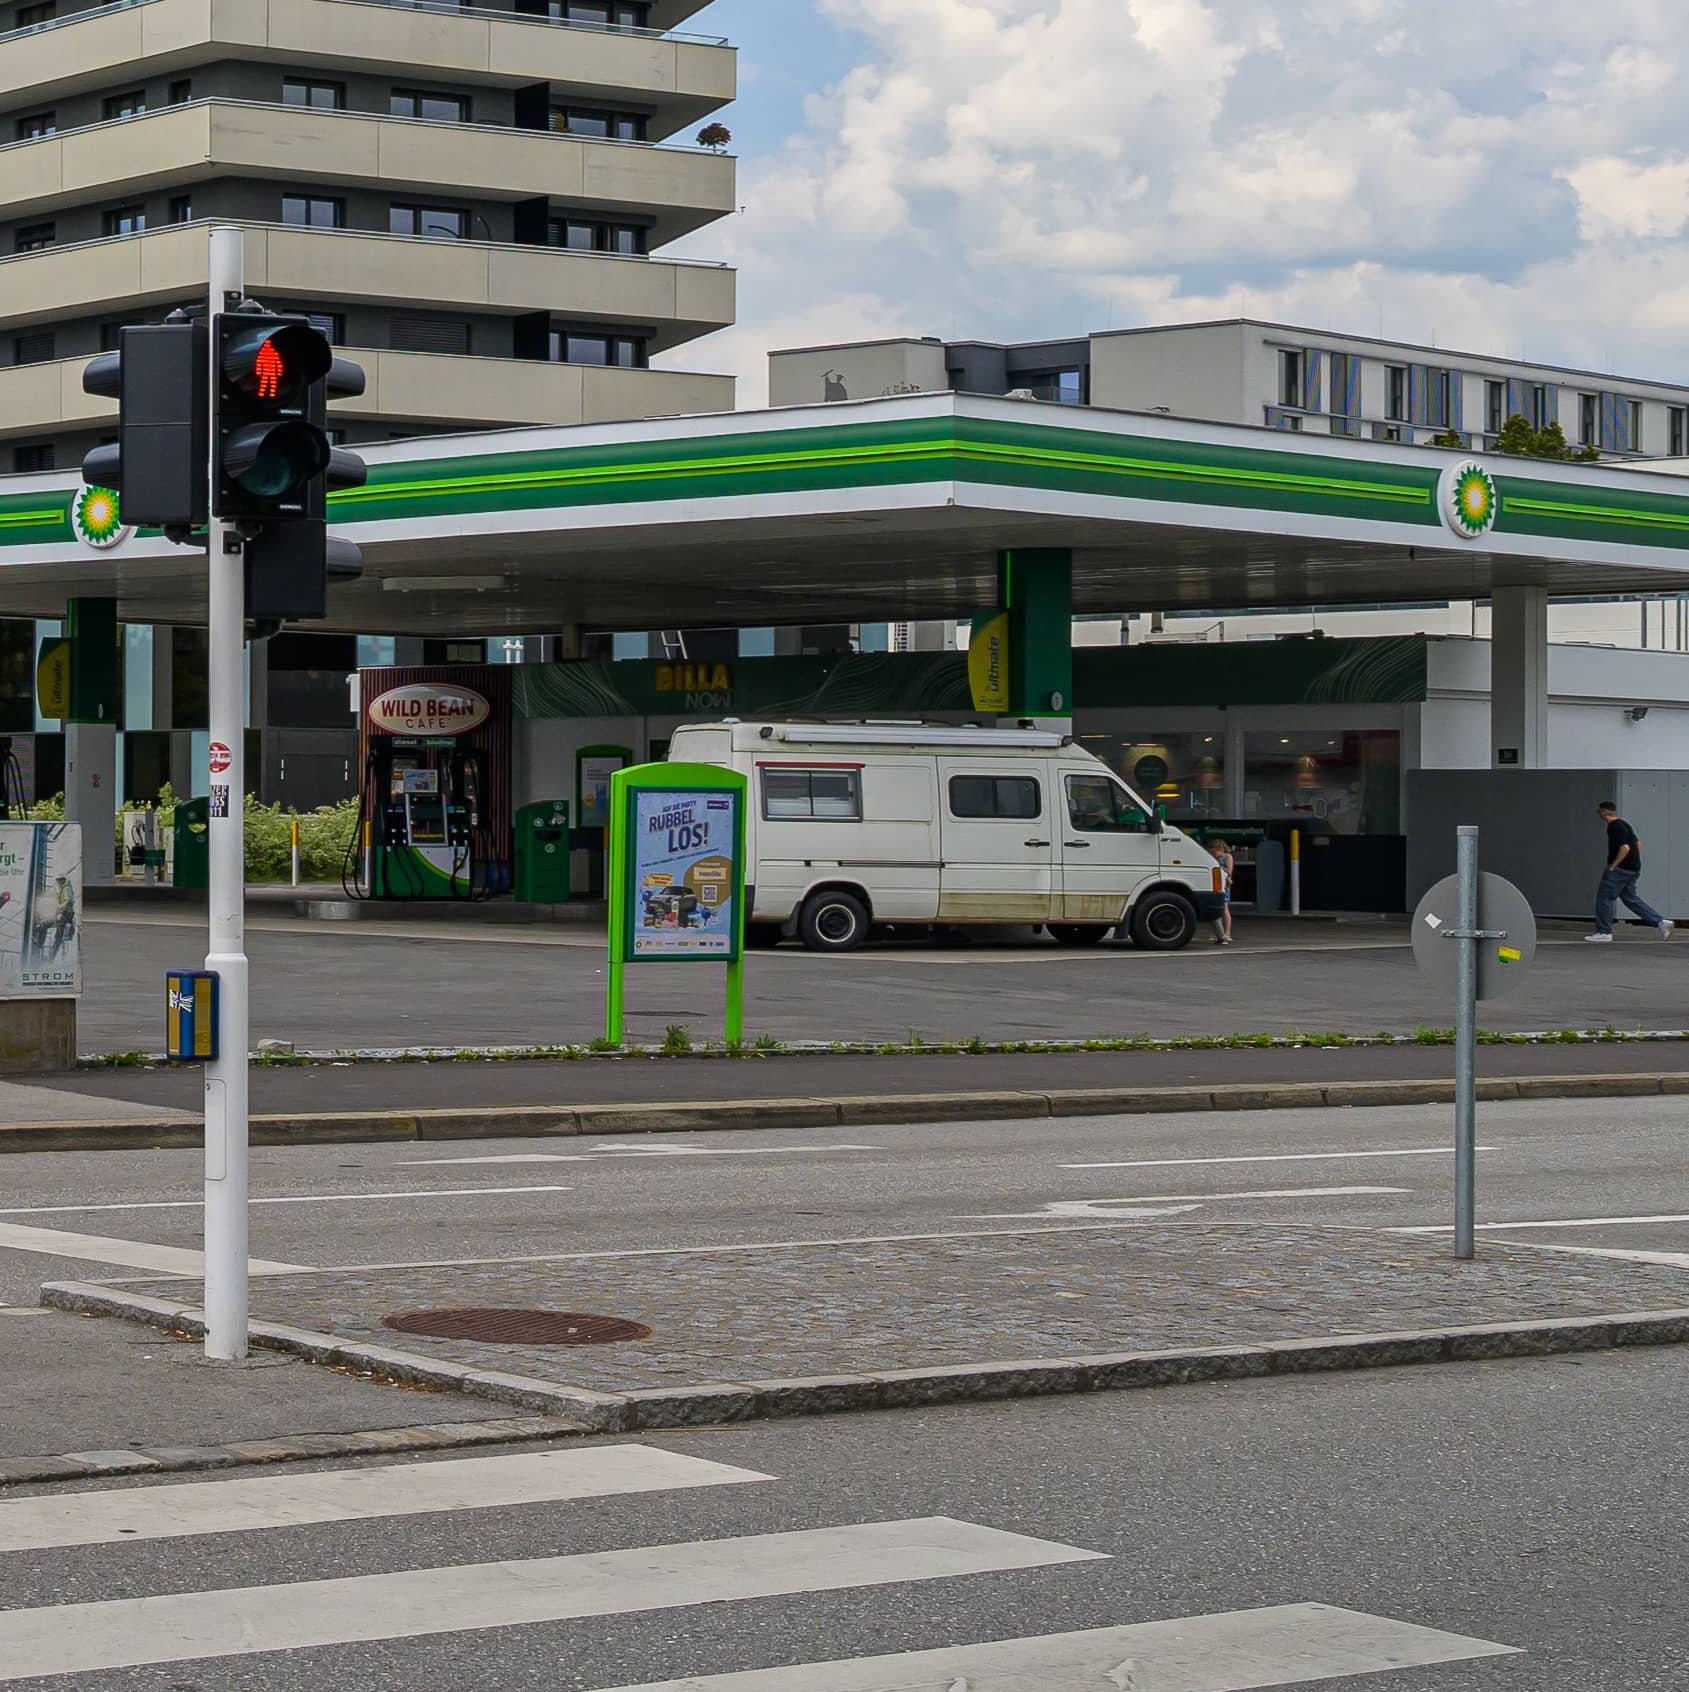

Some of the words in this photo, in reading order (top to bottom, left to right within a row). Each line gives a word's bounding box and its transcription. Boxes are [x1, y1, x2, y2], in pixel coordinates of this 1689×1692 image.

[987, 636, 1001, 693] ultimate
[656, 663, 729, 691] BILLA
[381, 698, 422, 718] WILD
[426, 697, 475, 717] BEAN
[685, 692, 731, 709] NOW
[648, 809, 696, 833] RUBBEL
[668, 822, 709, 853] LOS!
[10, 868, 25, 877] Uhr
[21, 972, 75, 982] STROM
